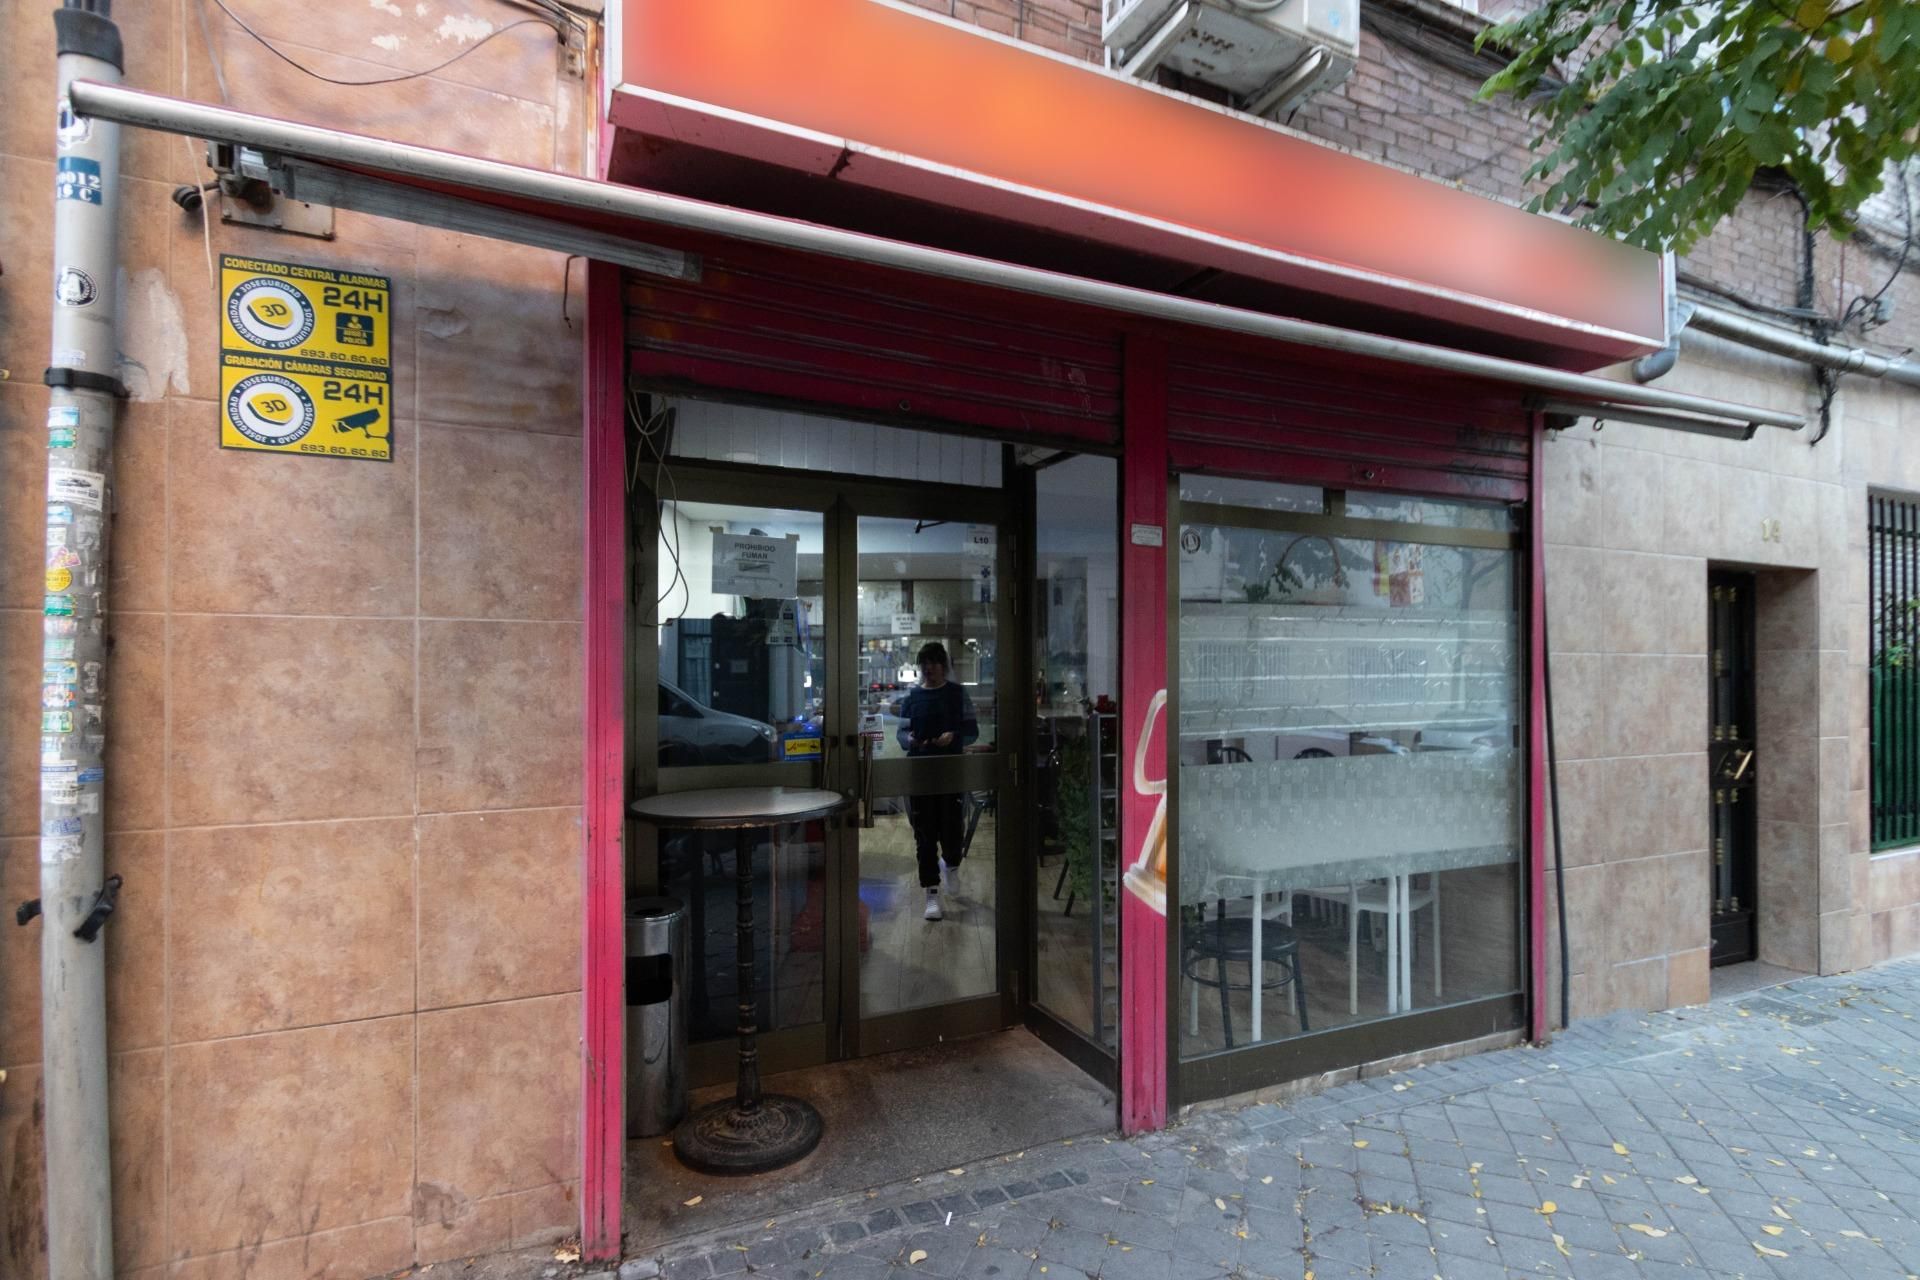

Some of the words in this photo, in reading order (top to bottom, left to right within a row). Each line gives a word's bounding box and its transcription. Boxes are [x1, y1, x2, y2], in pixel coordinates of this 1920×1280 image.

[224, 257, 288, 275] CONECTADO
[290, 266, 337, 282] CENTRAL
[339, 273, 387, 289] ALARMAS
[260, 303, 287, 318] 3D
[323, 287, 383, 313] 24H
[224, 355, 282, 370] GRABACIÓN
[284, 360, 332, 375] CÁMARAS
[334, 367, 387, 382] SEGURIDAD
[323, 381, 384, 405] 24H
[260, 399, 287, 414] 3D
[734, 542, 776, 552] PROHIBIDO
